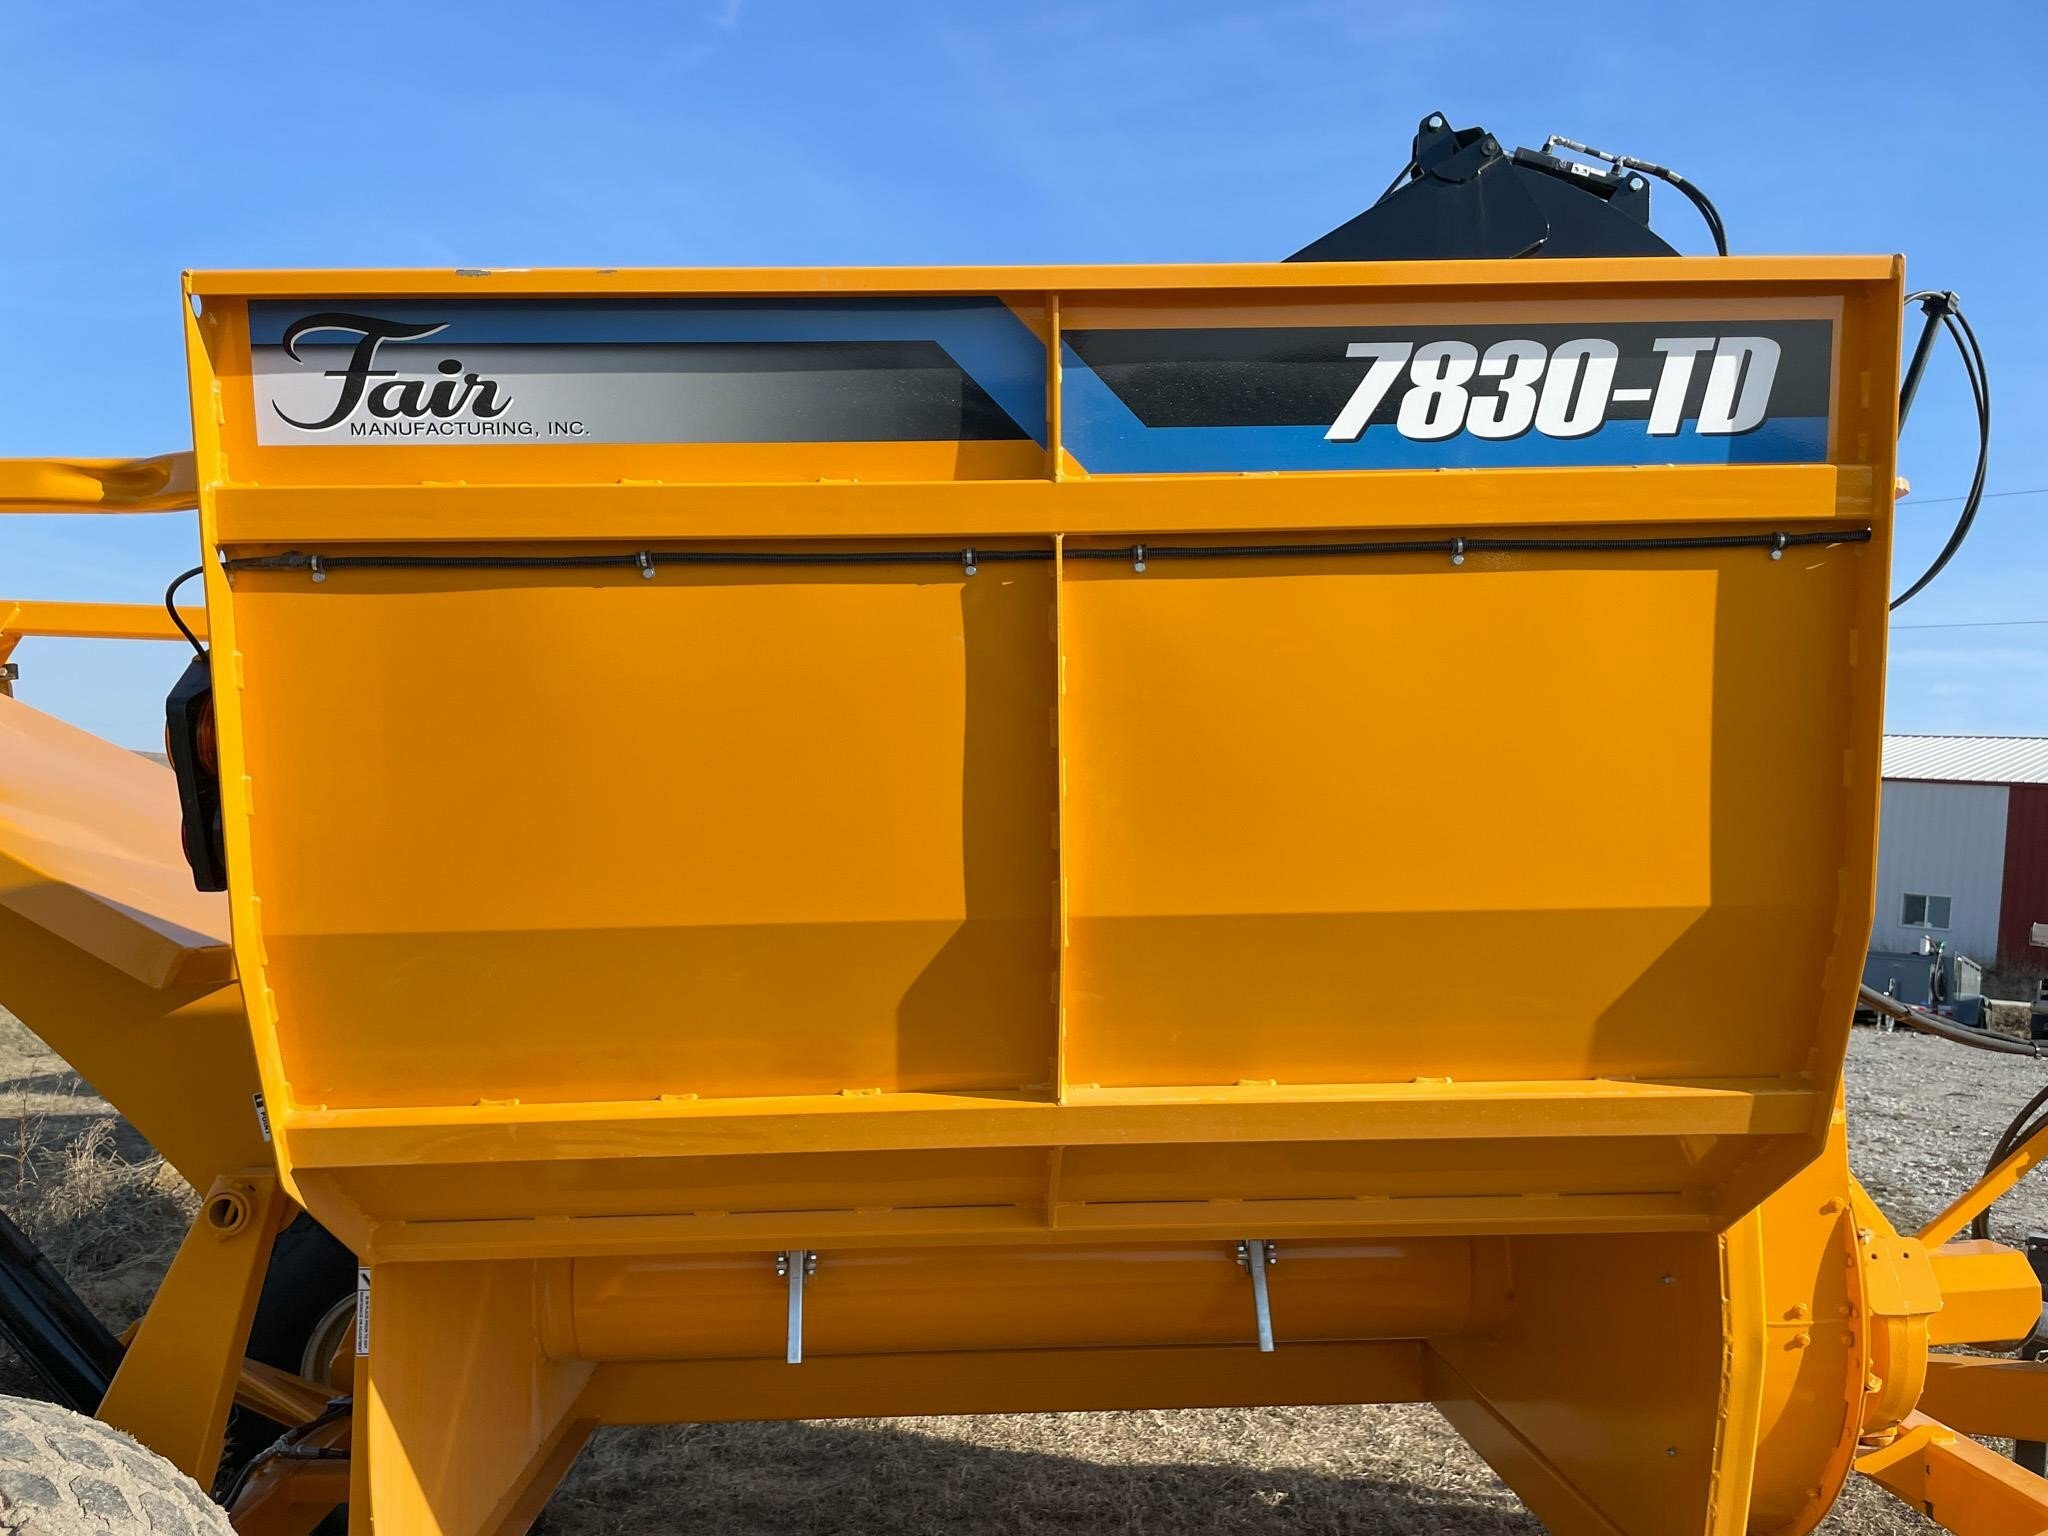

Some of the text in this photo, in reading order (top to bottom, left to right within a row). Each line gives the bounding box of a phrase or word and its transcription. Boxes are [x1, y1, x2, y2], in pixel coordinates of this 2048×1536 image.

[272, 312, 514, 432] Fair
[1323, 336, 1782, 441] 7830-TD
[350, 421, 590, 438] MANUFACTURING, INC.
